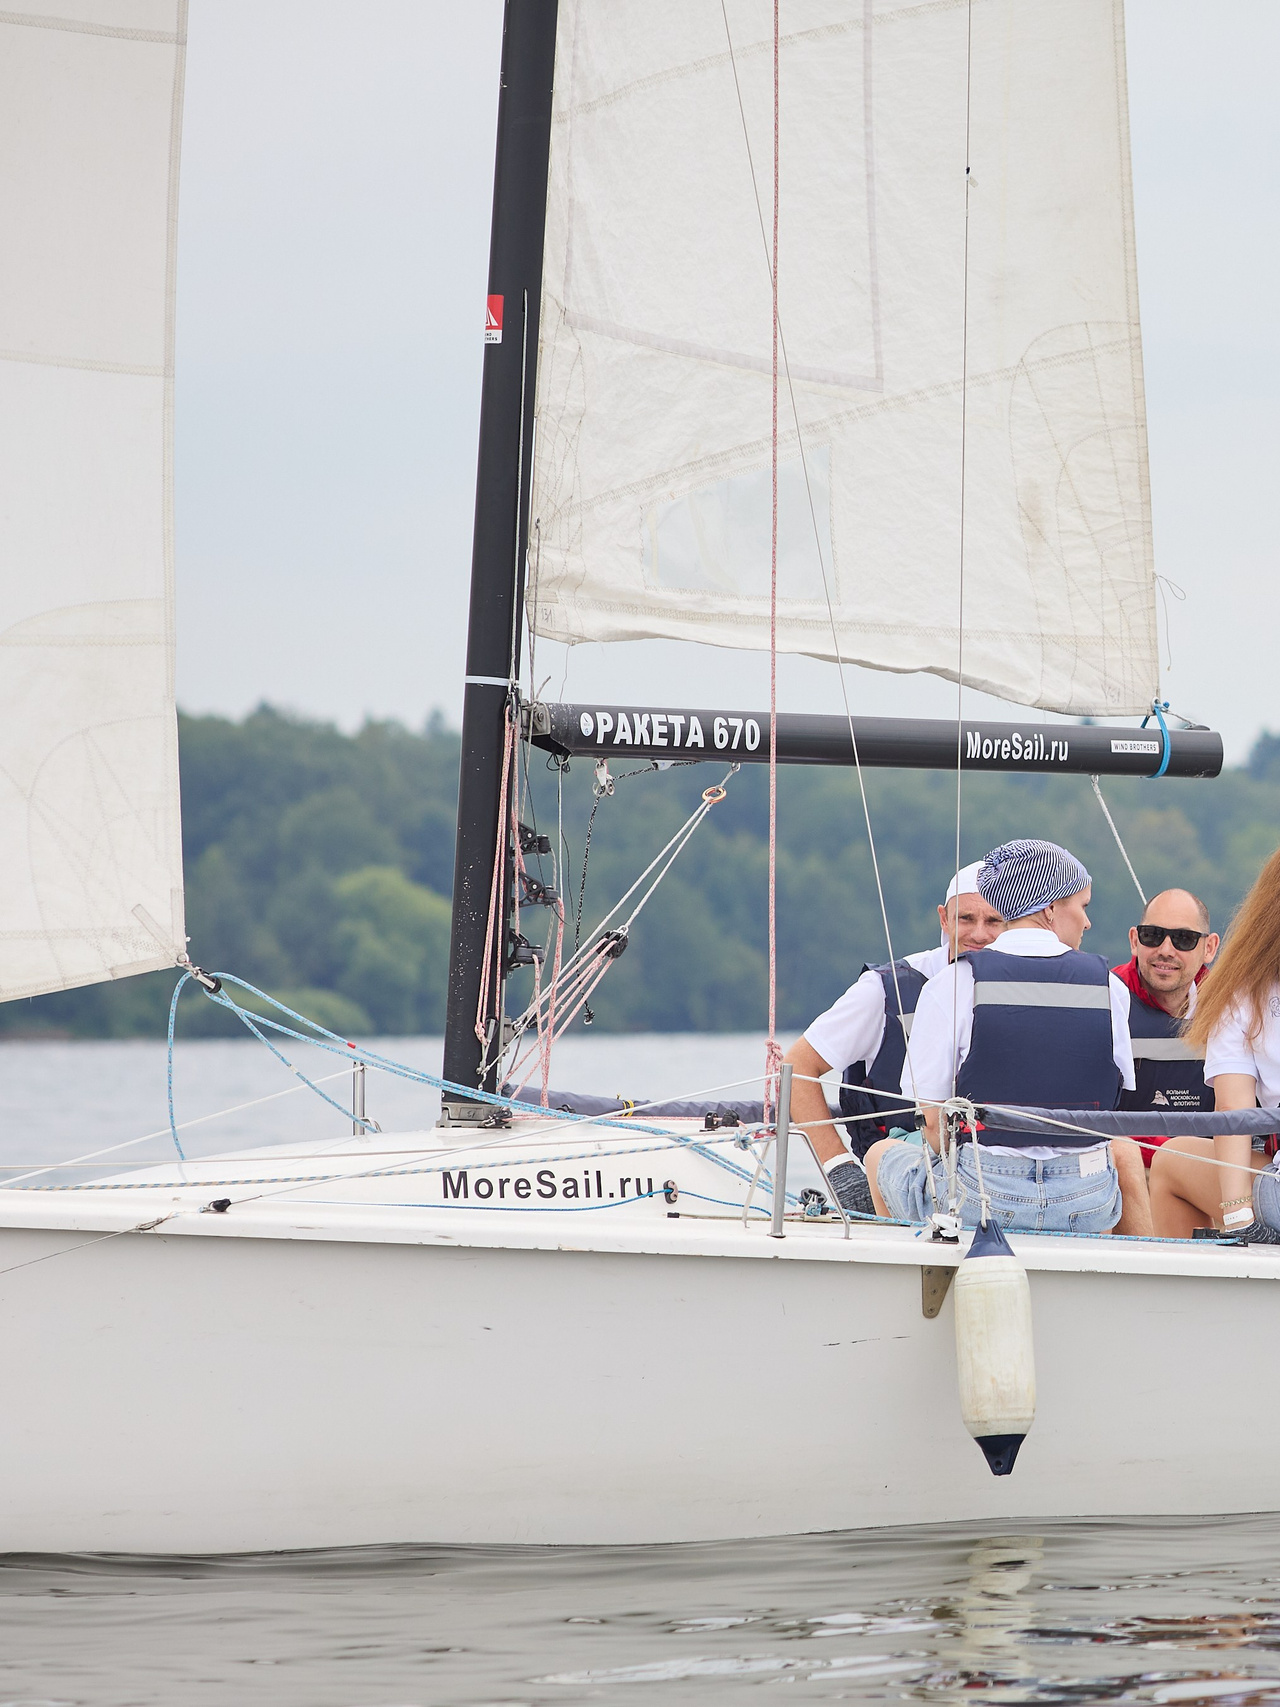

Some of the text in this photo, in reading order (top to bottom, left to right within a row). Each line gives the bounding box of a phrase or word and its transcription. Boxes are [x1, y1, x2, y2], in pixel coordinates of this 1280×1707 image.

[596, 712, 705, 748] РАКЕТА
[713, 717, 761, 751] 670
[966, 731, 1069, 761] MoreSail.ru
[1129, 743, 1157, 752] BROTHERS
[442, 1170, 653, 1199] MoreSail.ru
